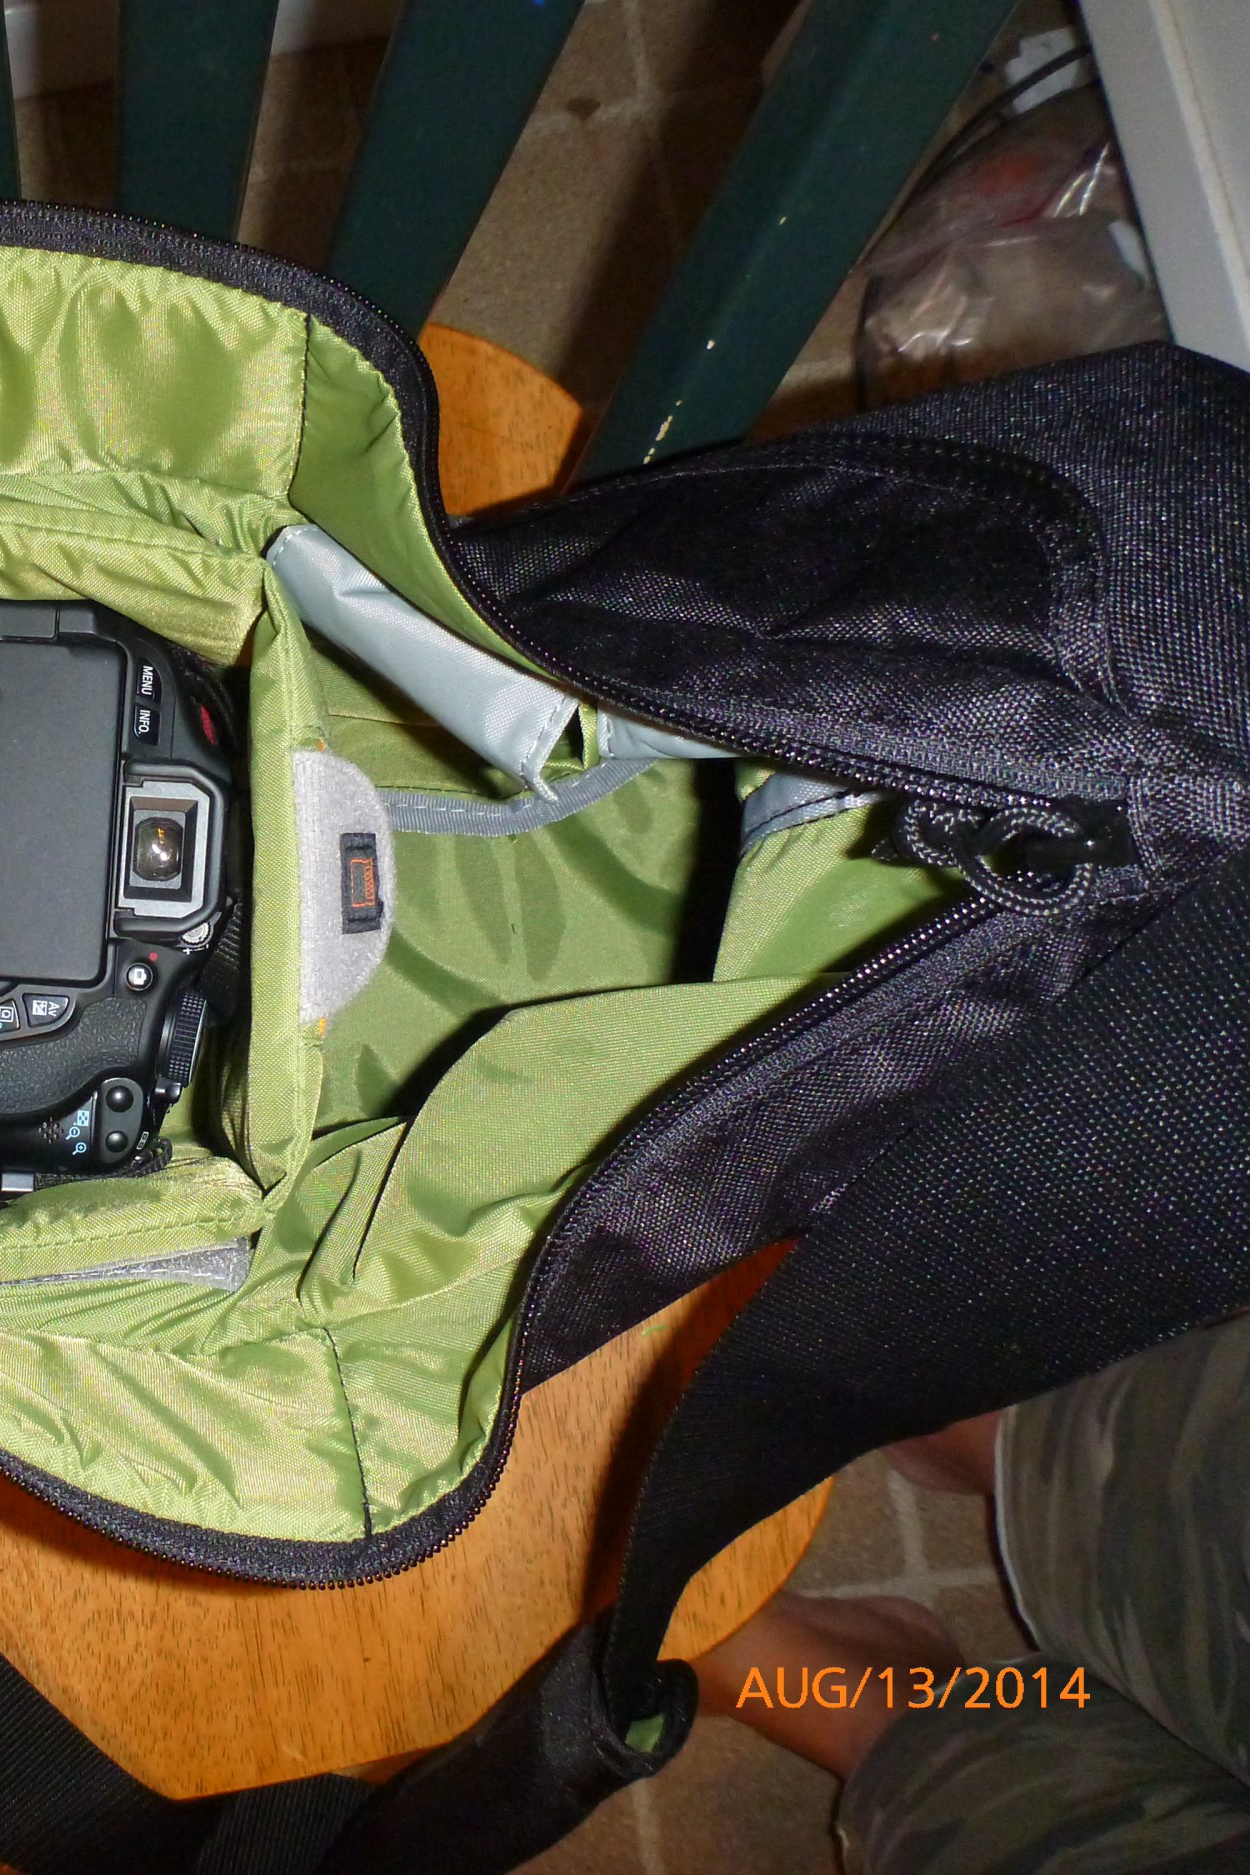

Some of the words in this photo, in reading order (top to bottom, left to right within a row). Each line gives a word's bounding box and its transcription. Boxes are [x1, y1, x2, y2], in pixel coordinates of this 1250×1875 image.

[141, 665, 153, 695] MENU
[138, 710, 151, 734] INFO.
[48, 1002, 60, 1017] Av
